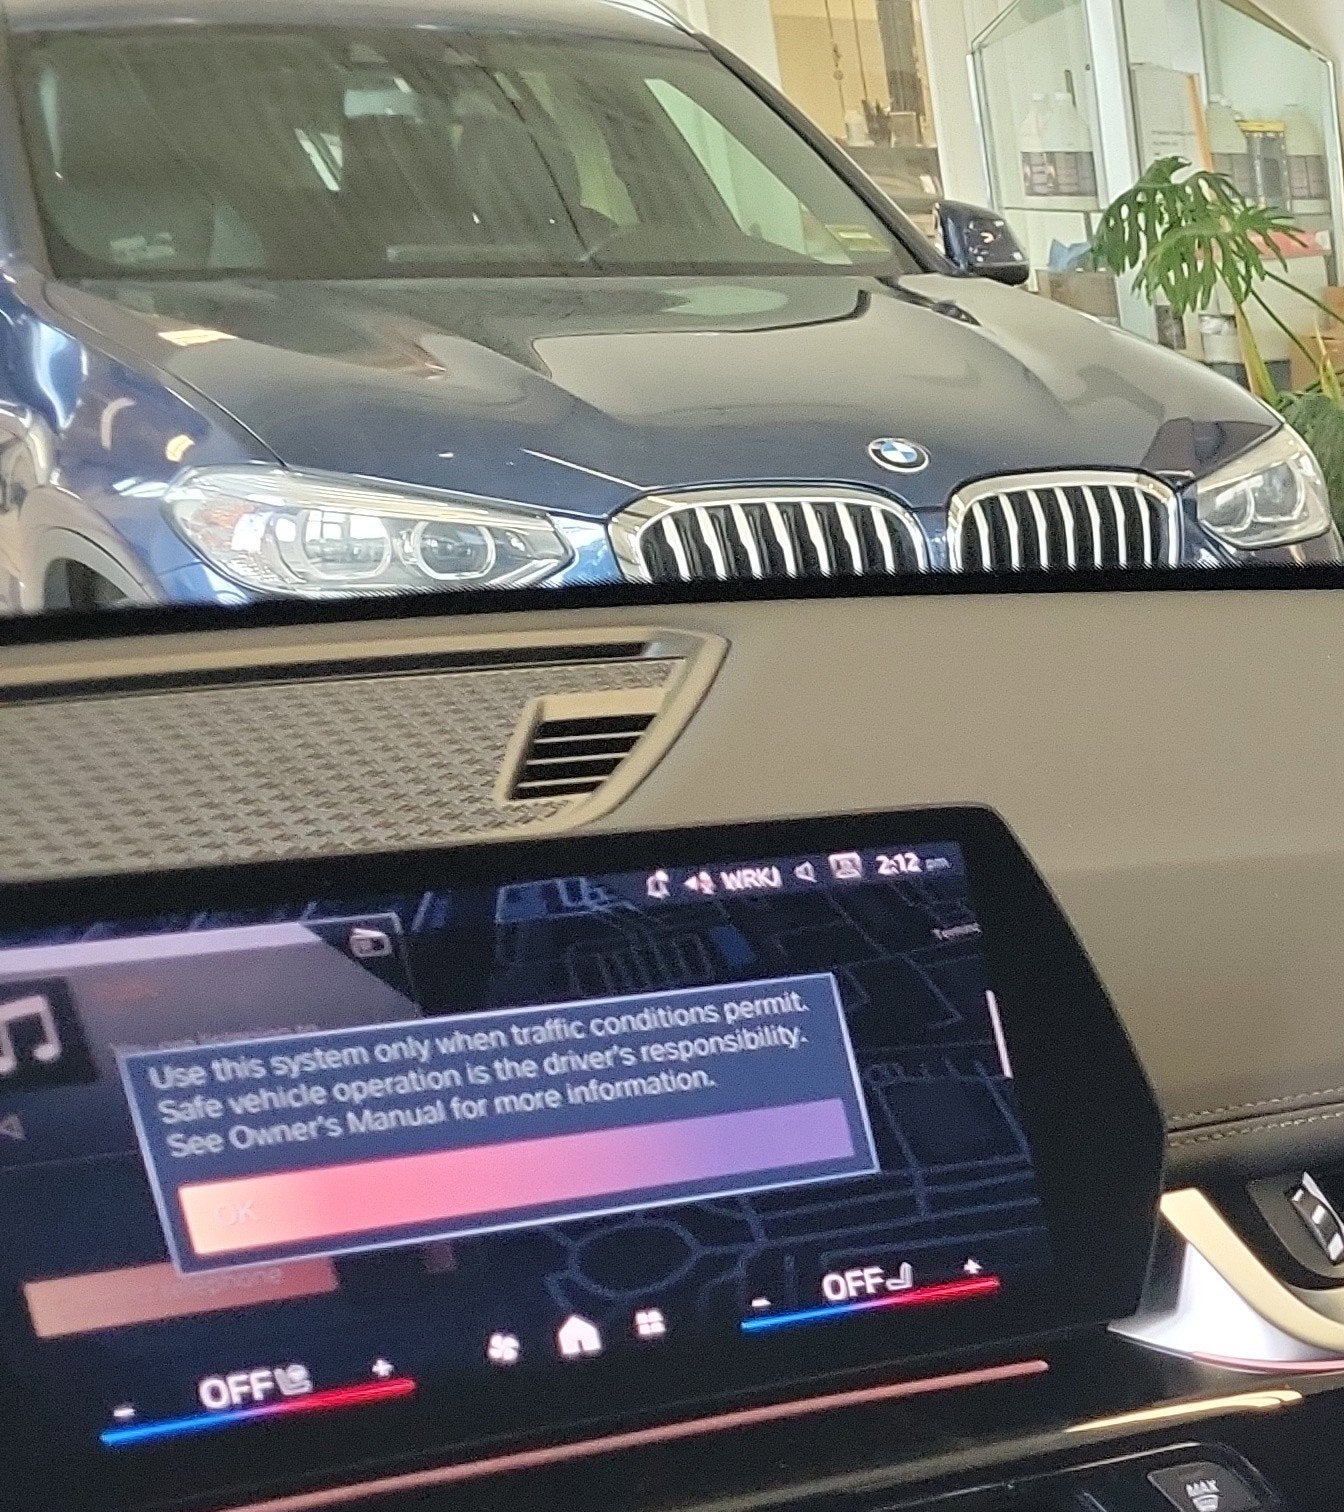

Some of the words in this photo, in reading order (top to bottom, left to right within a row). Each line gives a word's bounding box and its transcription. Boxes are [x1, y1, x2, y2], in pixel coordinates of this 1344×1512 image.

[876, 852, 922, 876] 2:12
[149, 1063, 207, 1091] Use
[212, 1056, 267, 1083] this
[270, 1043, 370, 1079] system
[374, 1034, 432, 1064] only
[436, 1027, 509, 1054] when
[510, 1018, 585, 1048] traffic
[590, 1002, 720, 1037] conditions
[722, 990, 809, 1026] permit.
[157, 1095, 224, 1125] Safe
[228, 1082, 327, 1114] vehicle
[331, 1068, 462, 1103] operation
[466, 1061, 491, 1086] is
[494, 1055, 537, 1082] the
[543, 1043, 636, 1076] driver's
[641, 1024, 808, 1064] responsibility.
[165, 1131, 224, 1159] See
[228, 1115, 343, 1151] Owner's
[346, 1101, 445, 1134] Manual
[450, 1094, 487, 1120] for
[494, 1086, 562, 1115] more
[566, 1068, 717, 1107] information.
[822, 1266, 885, 1301] OFF
[199, 1368, 275, 1411] OFF
